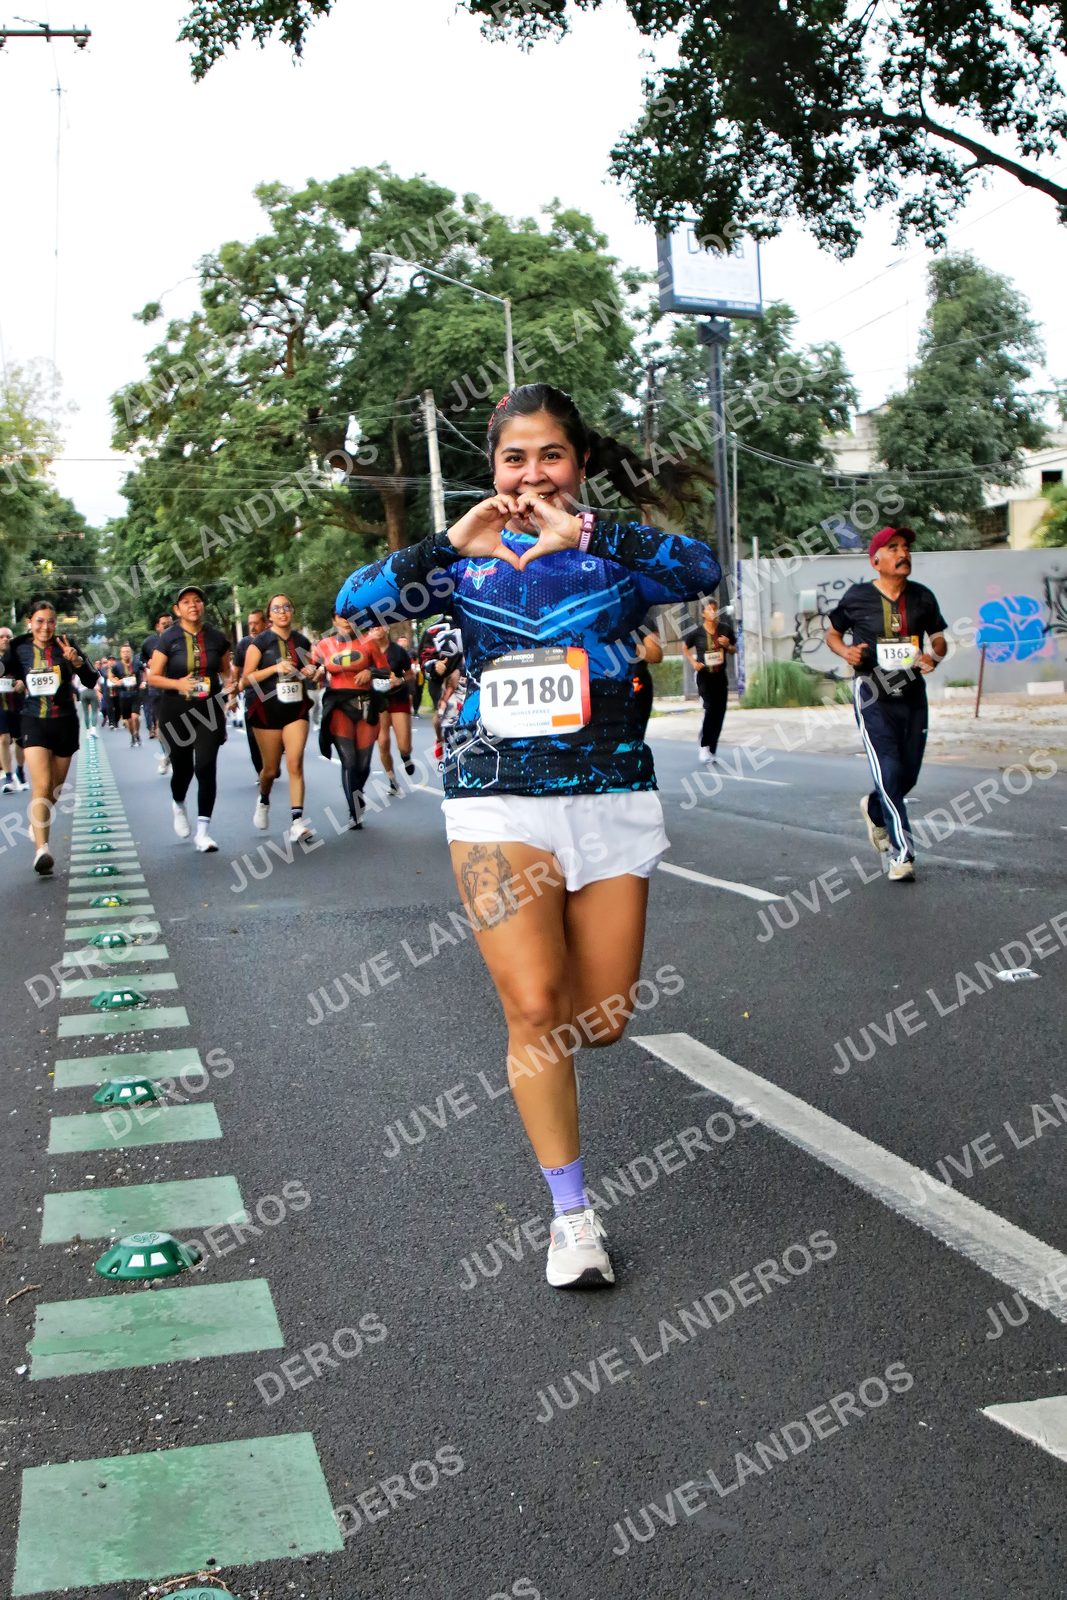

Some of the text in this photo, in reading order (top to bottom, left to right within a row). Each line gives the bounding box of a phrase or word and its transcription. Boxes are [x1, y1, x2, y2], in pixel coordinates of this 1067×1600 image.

[884, 648, 910, 659] 1365
[31, 676, 54, 686] 5895
[282, 685, 299, 695] 5367
[486, 674, 574, 708] 12180
